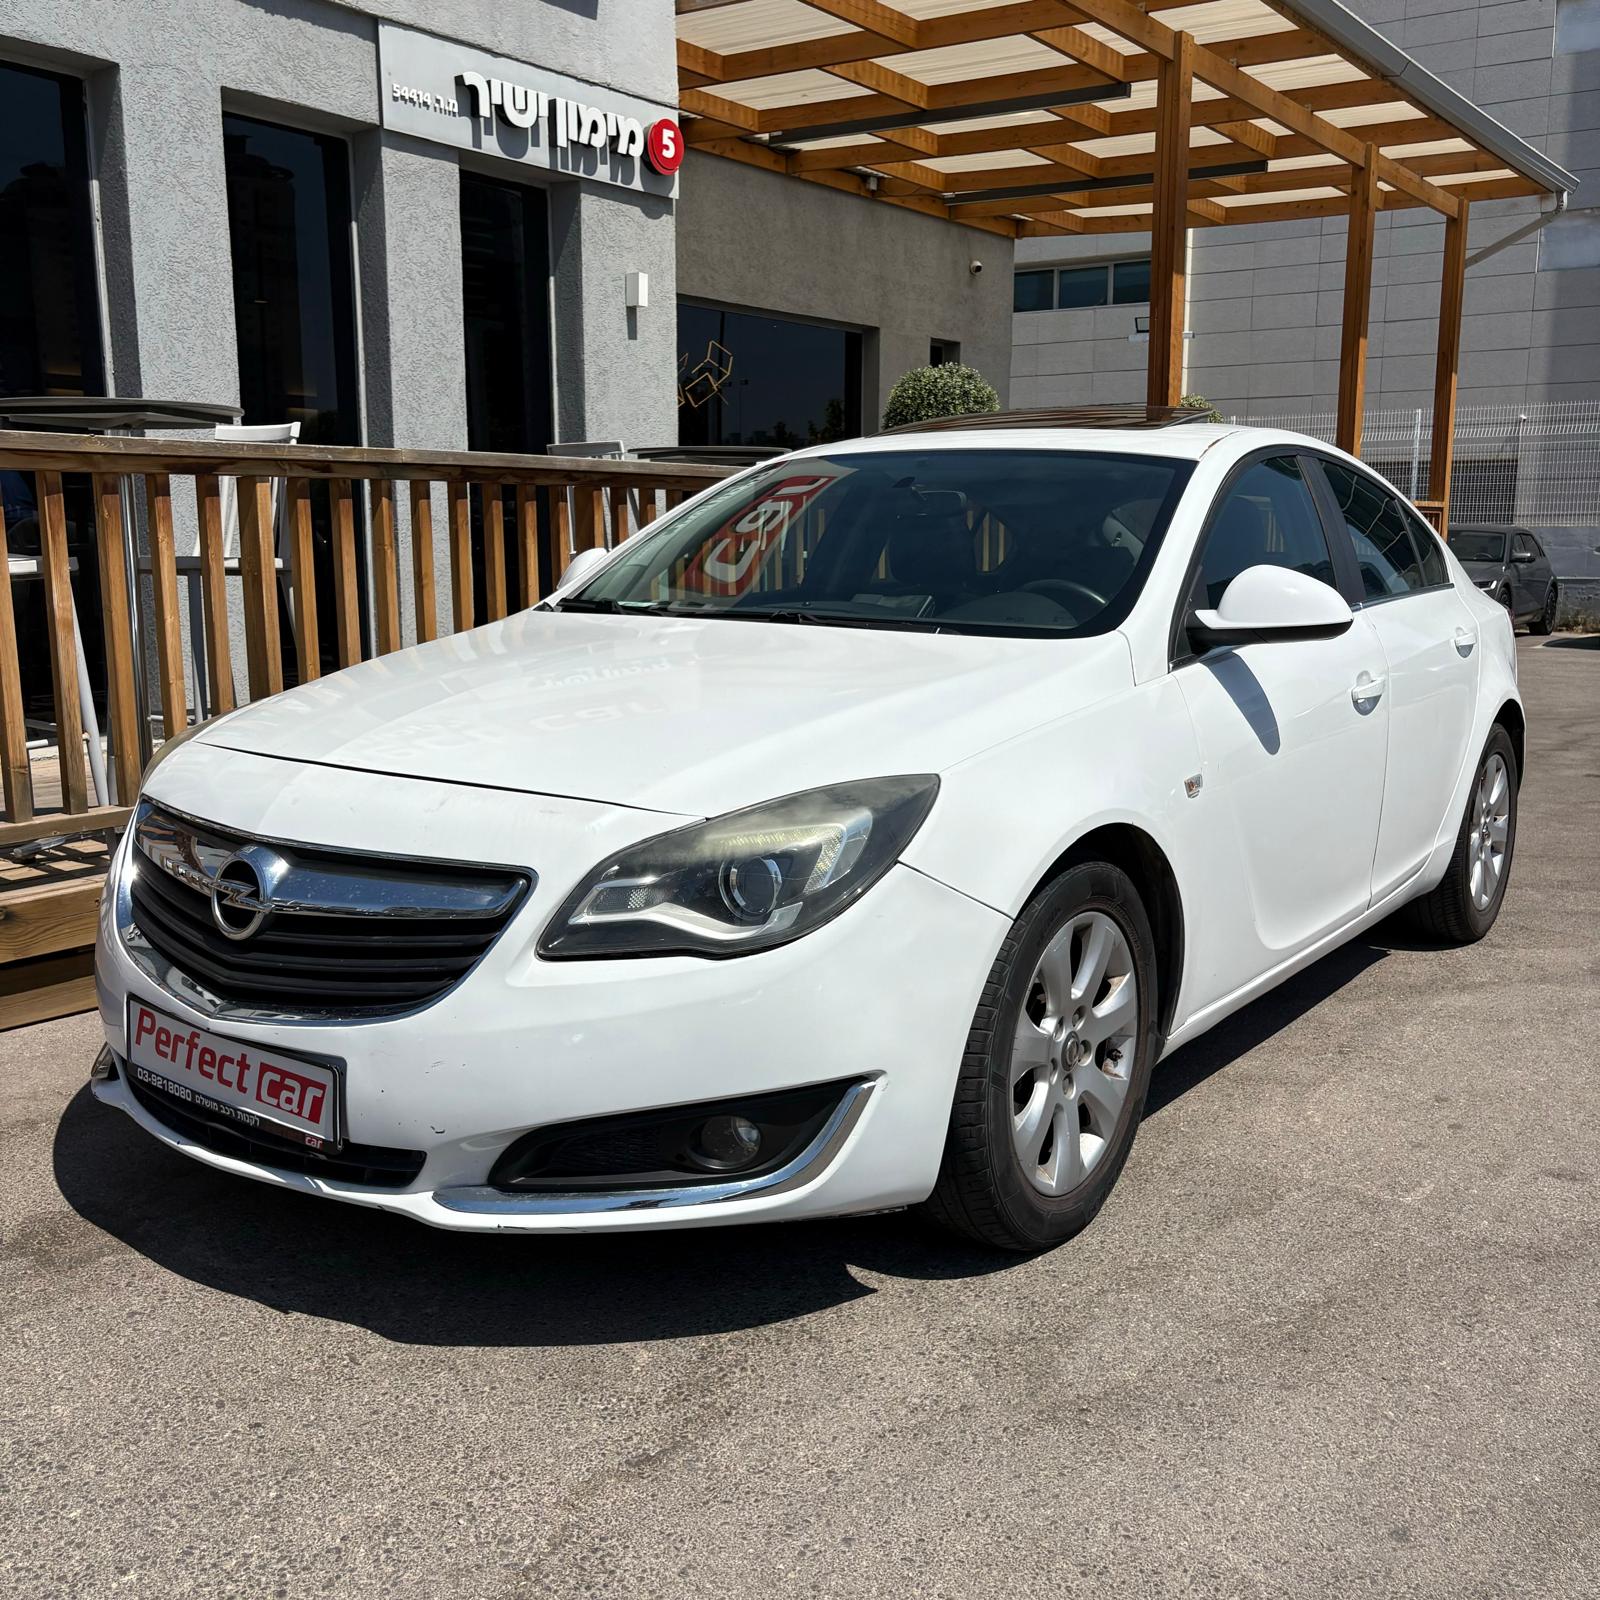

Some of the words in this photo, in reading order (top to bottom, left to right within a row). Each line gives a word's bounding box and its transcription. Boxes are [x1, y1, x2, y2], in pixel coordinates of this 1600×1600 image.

[392, 83, 432, 106] 54414
[460, 71, 549, 129] ישיר
[555, 97, 645, 158] מימון
[661, 128, 676, 159] 5
[135, 1007, 252, 1094] Perfect
[260, 1070, 324, 1120] car
[137, 1067, 192, 1101] 03-9218080
[305, 1136, 323, 1149] car
